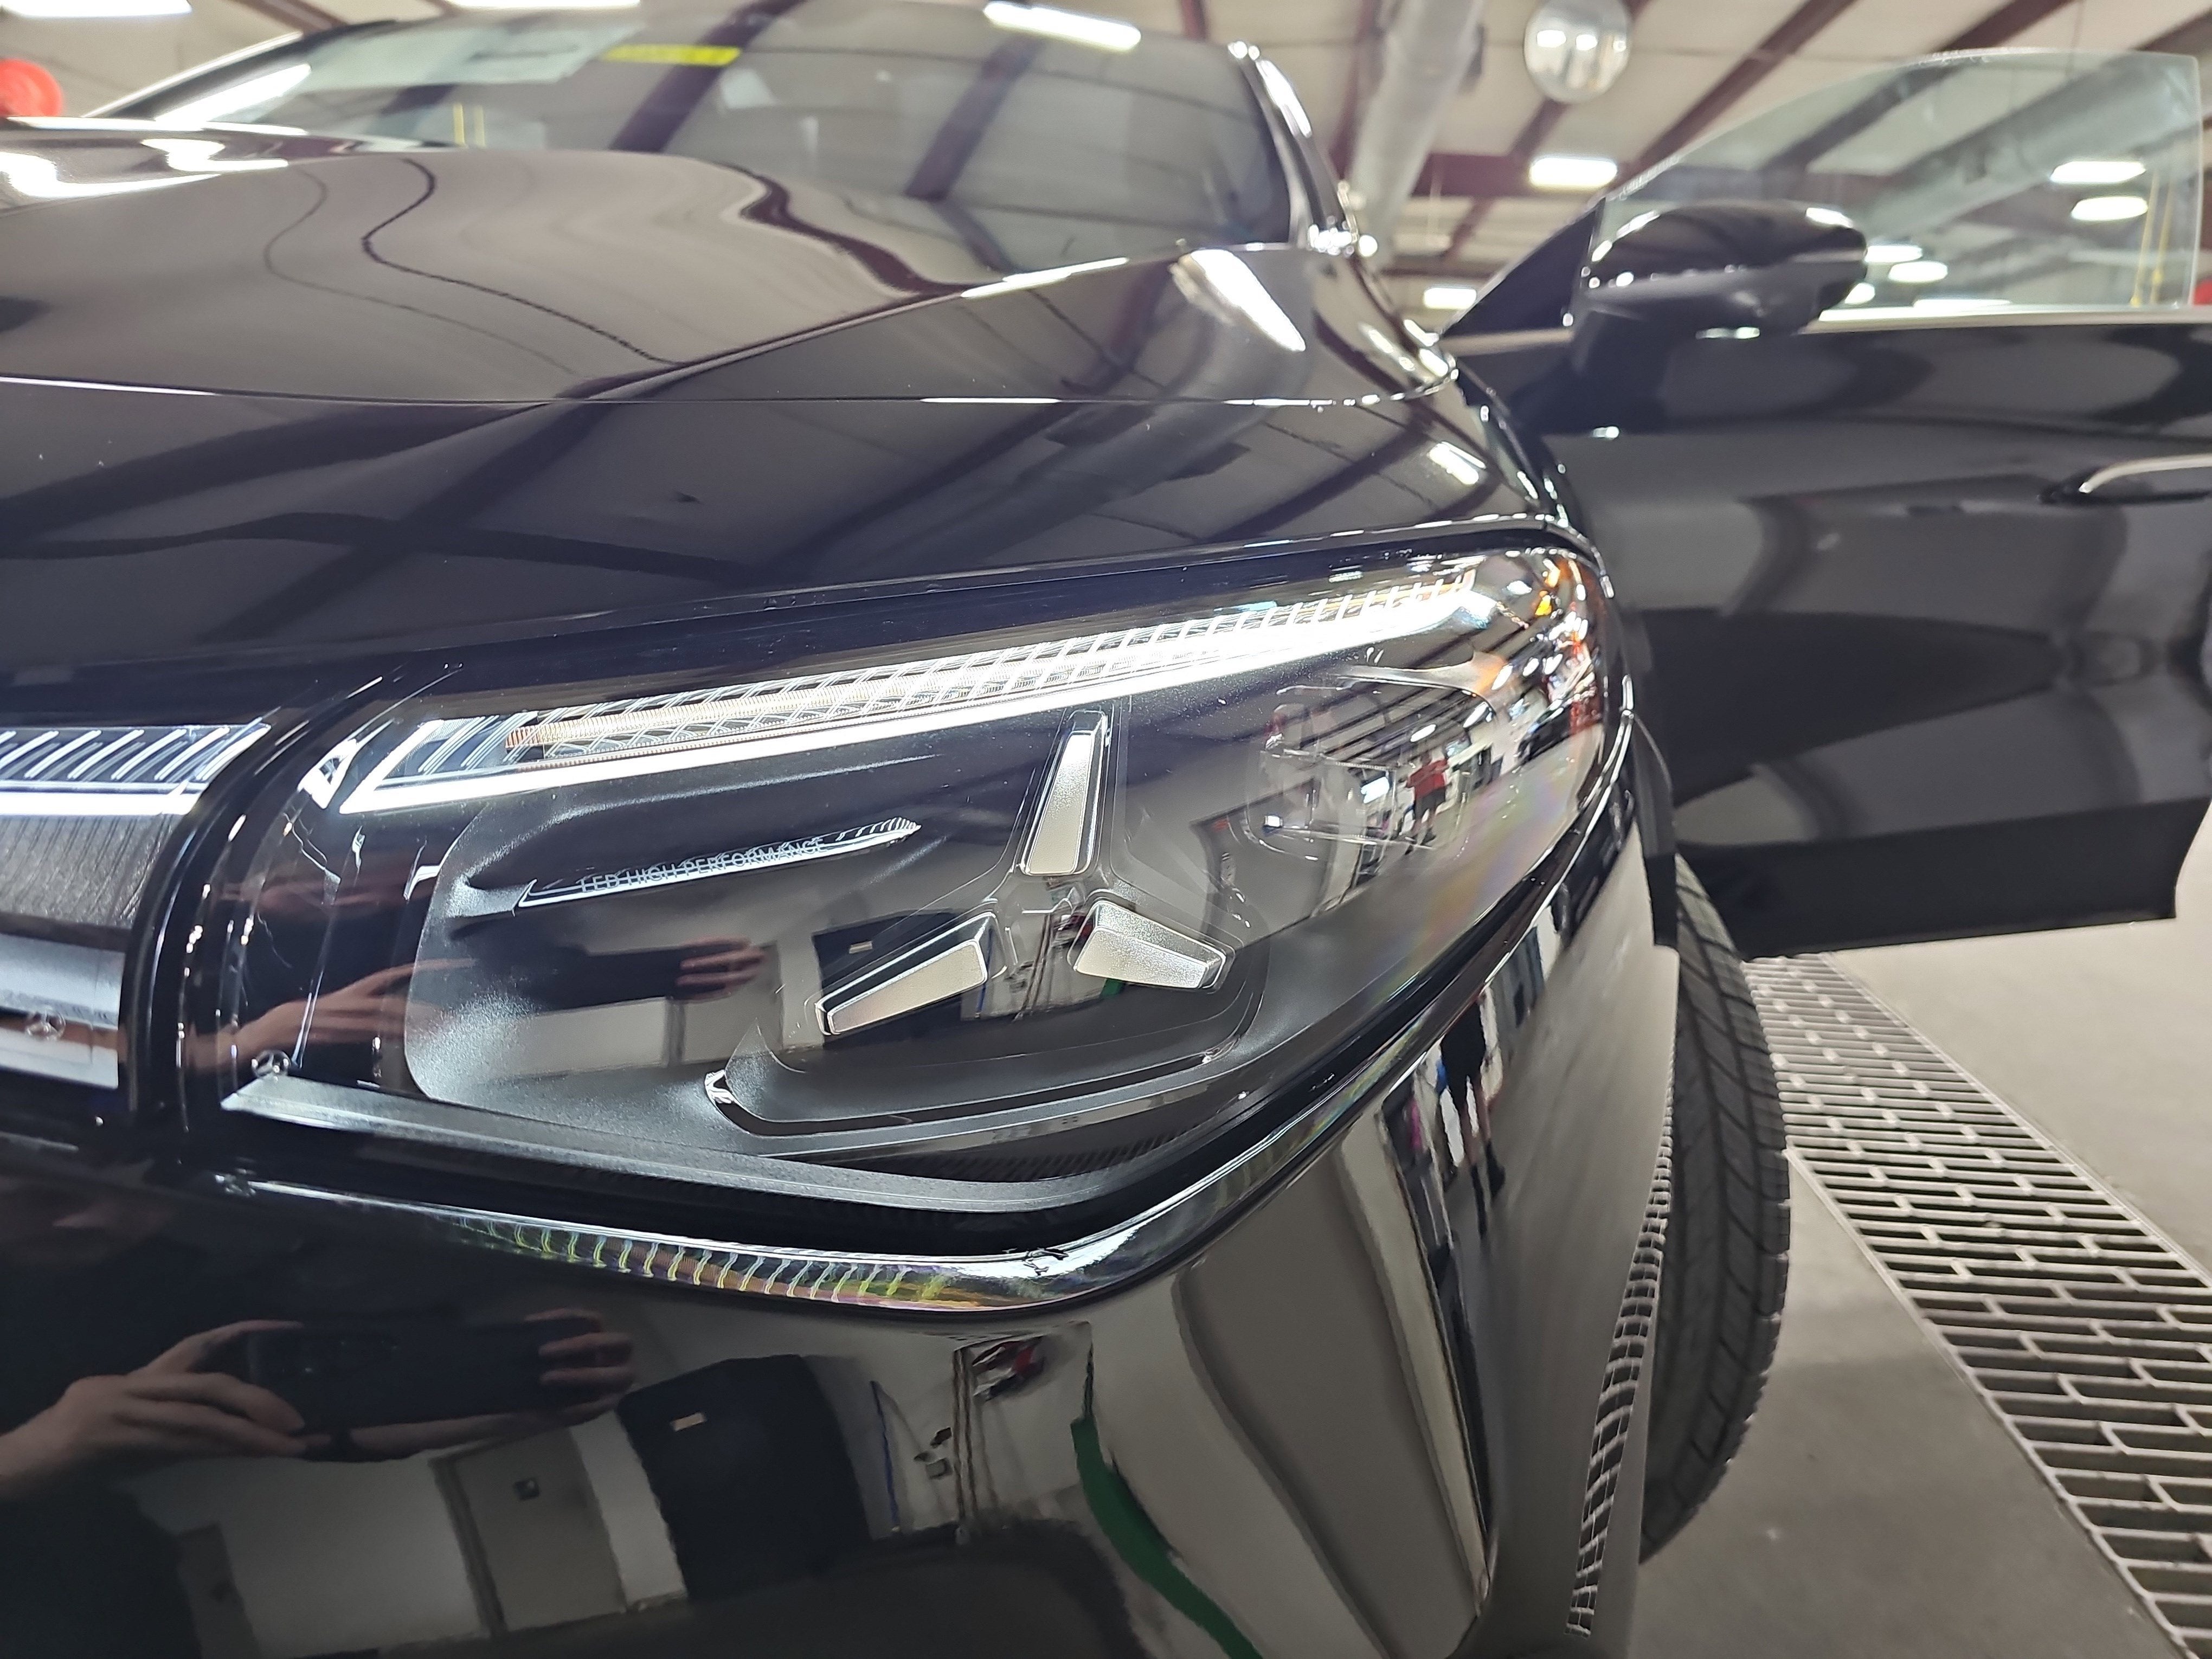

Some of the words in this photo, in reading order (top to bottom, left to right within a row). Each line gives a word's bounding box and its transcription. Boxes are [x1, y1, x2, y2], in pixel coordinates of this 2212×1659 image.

[581, 873, 620, 893] LED
[626, 864, 678, 886] HIGH
[684, 838, 828, 876] PERFORMANCE
